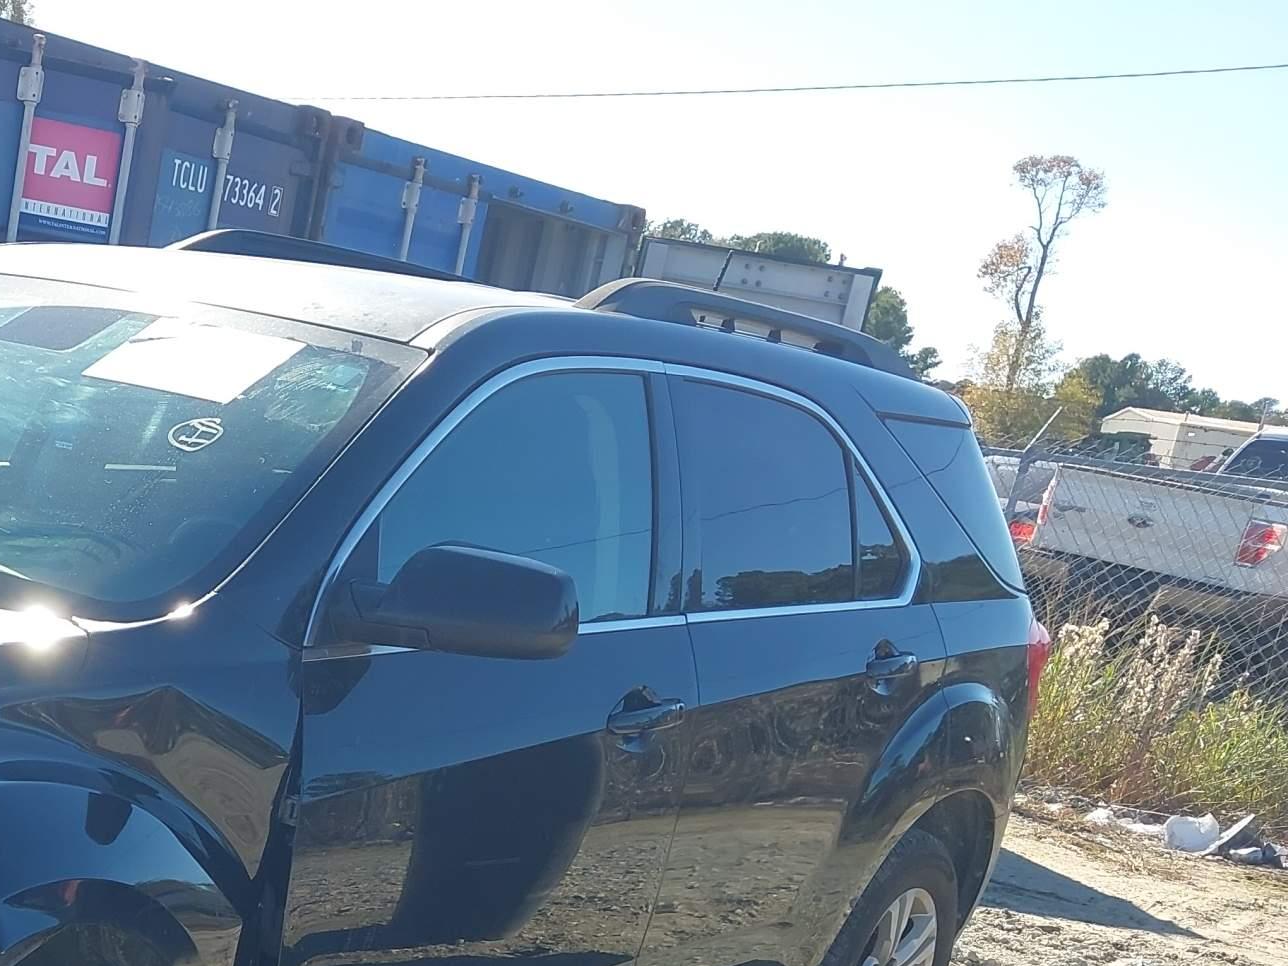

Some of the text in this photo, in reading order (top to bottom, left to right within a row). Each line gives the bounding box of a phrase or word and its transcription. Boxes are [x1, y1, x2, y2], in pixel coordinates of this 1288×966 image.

[172, 159, 208, 193] TCLU
[223, 175, 266, 211] 73364
[23, 201, 108, 225] NTERNATIONAL
